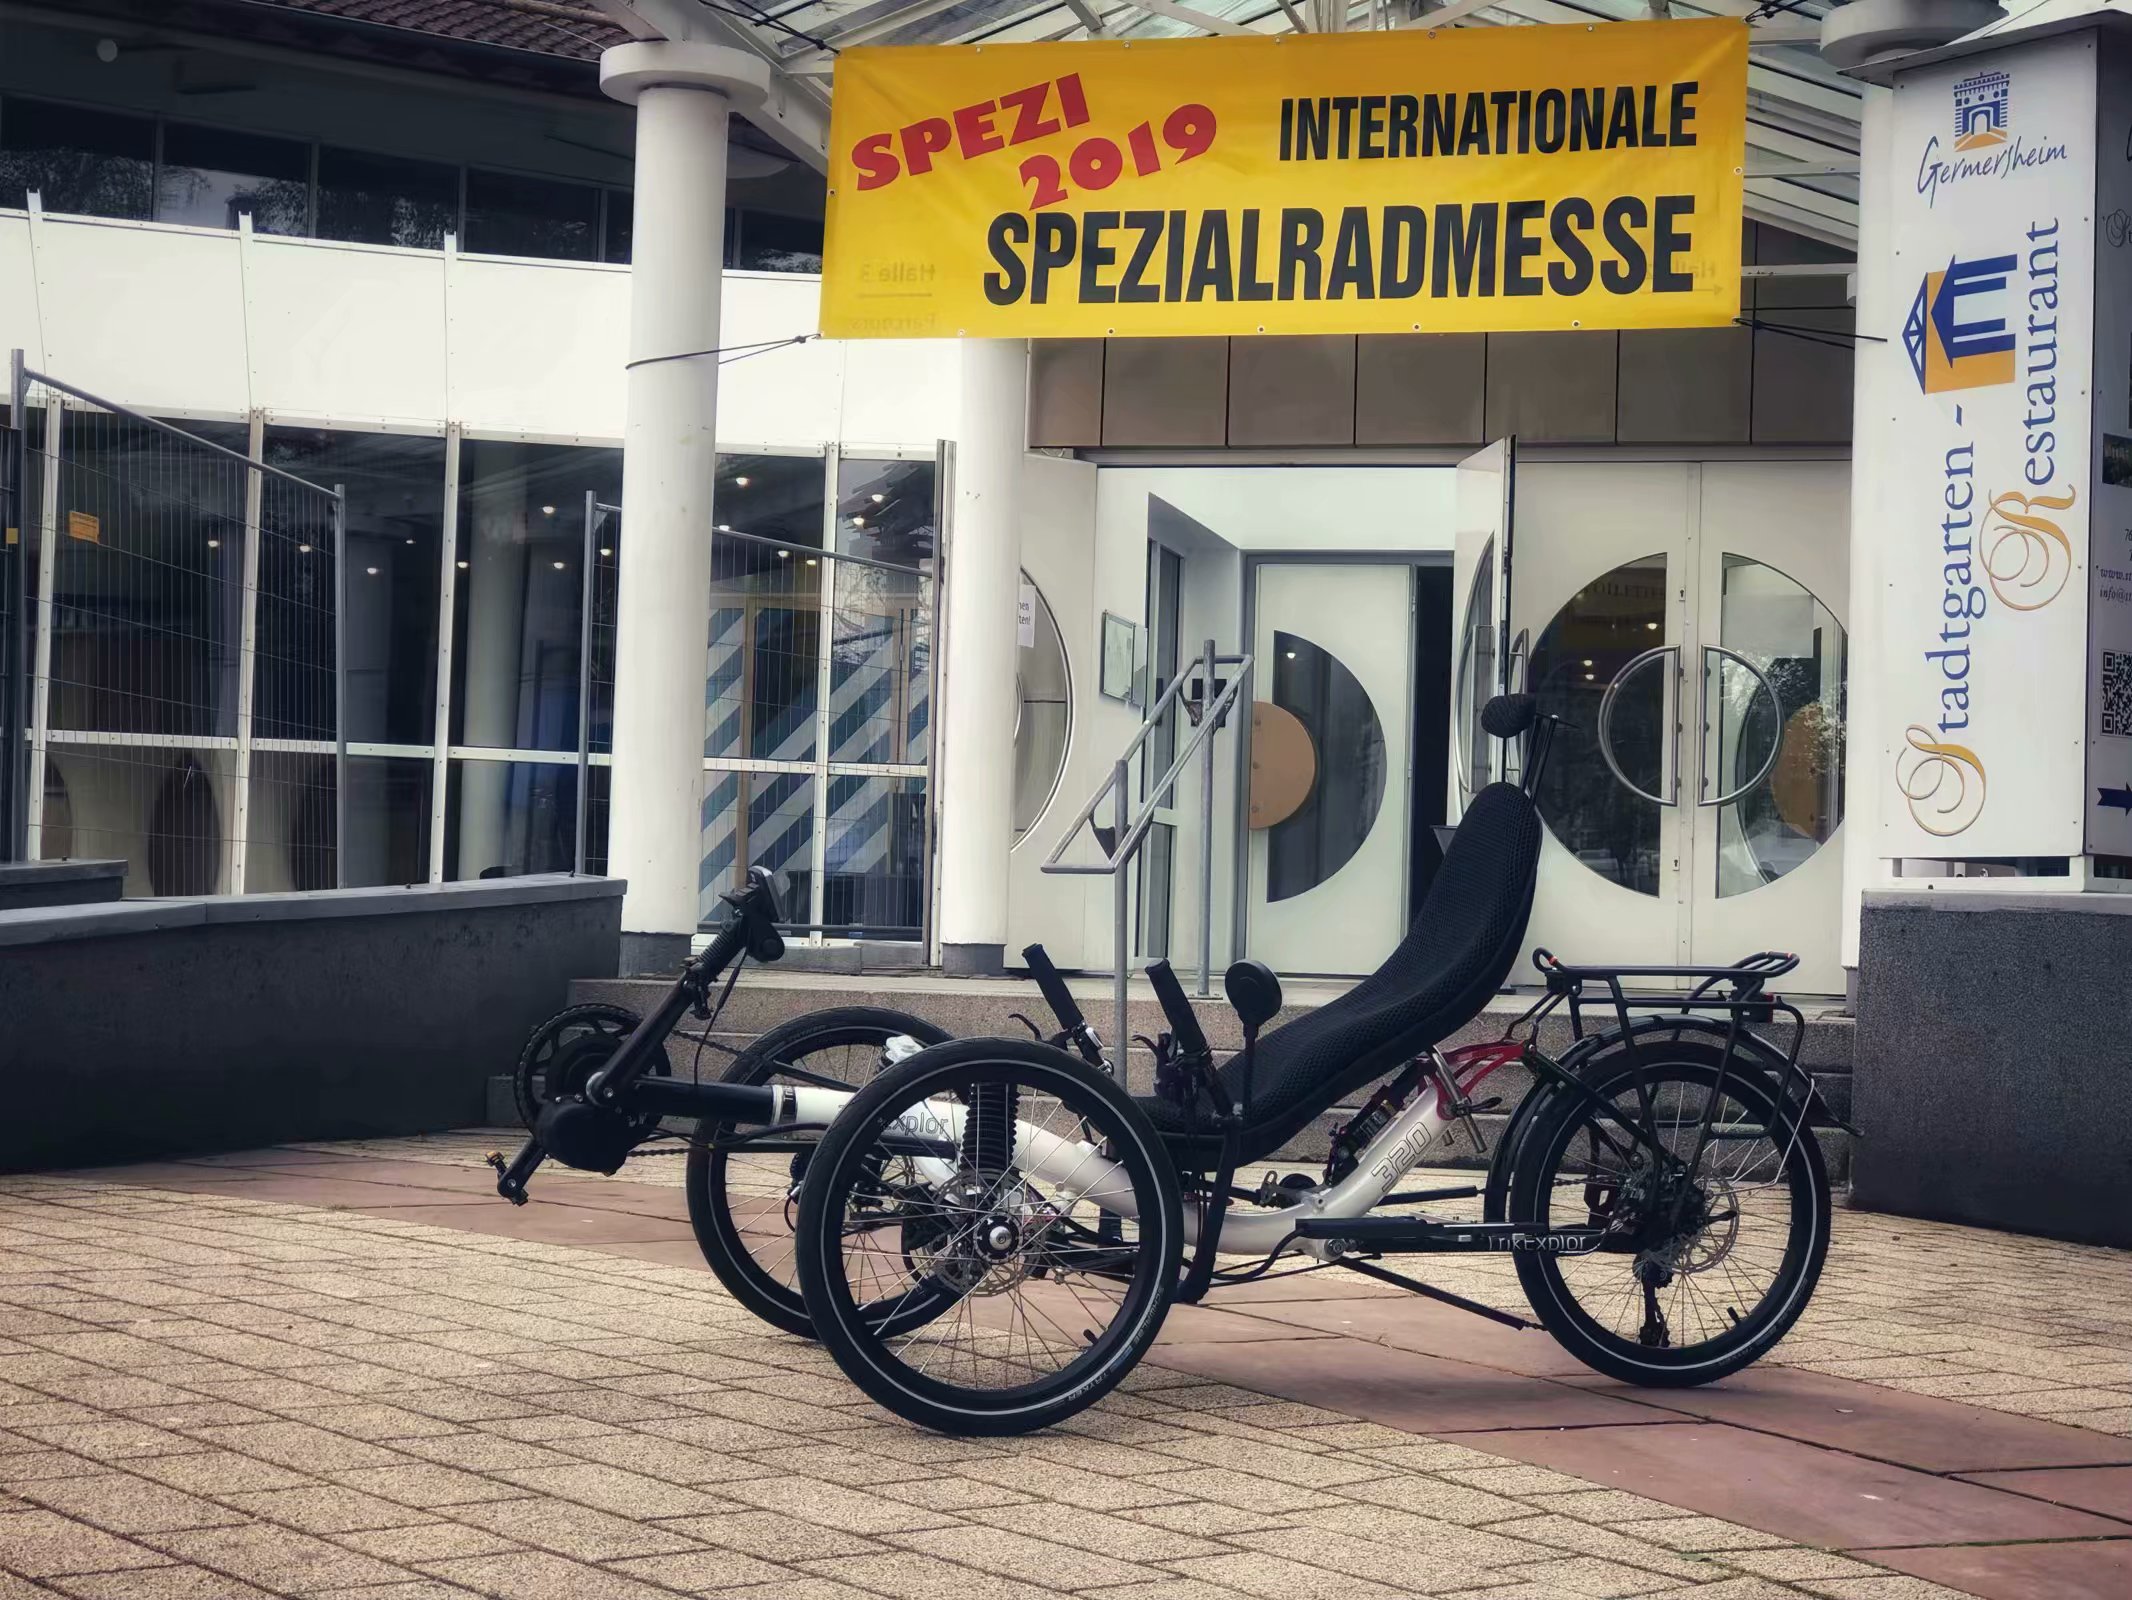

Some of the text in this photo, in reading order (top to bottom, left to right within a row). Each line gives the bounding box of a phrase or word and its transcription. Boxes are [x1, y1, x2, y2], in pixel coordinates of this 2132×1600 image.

[851, 73, 1090, 191] SPEZI
[1019, 103, 1217, 210] 2019
[1279, 81, 1699, 162] INTERNATIONALE
[1917, 134, 2068, 209] Germersheim
[983, 195, 1695, 306] SPEZIALRADMESSE
[1979, 216, 2077, 611] Restaurant
[1371, 1121, 1432, 1193] 320
